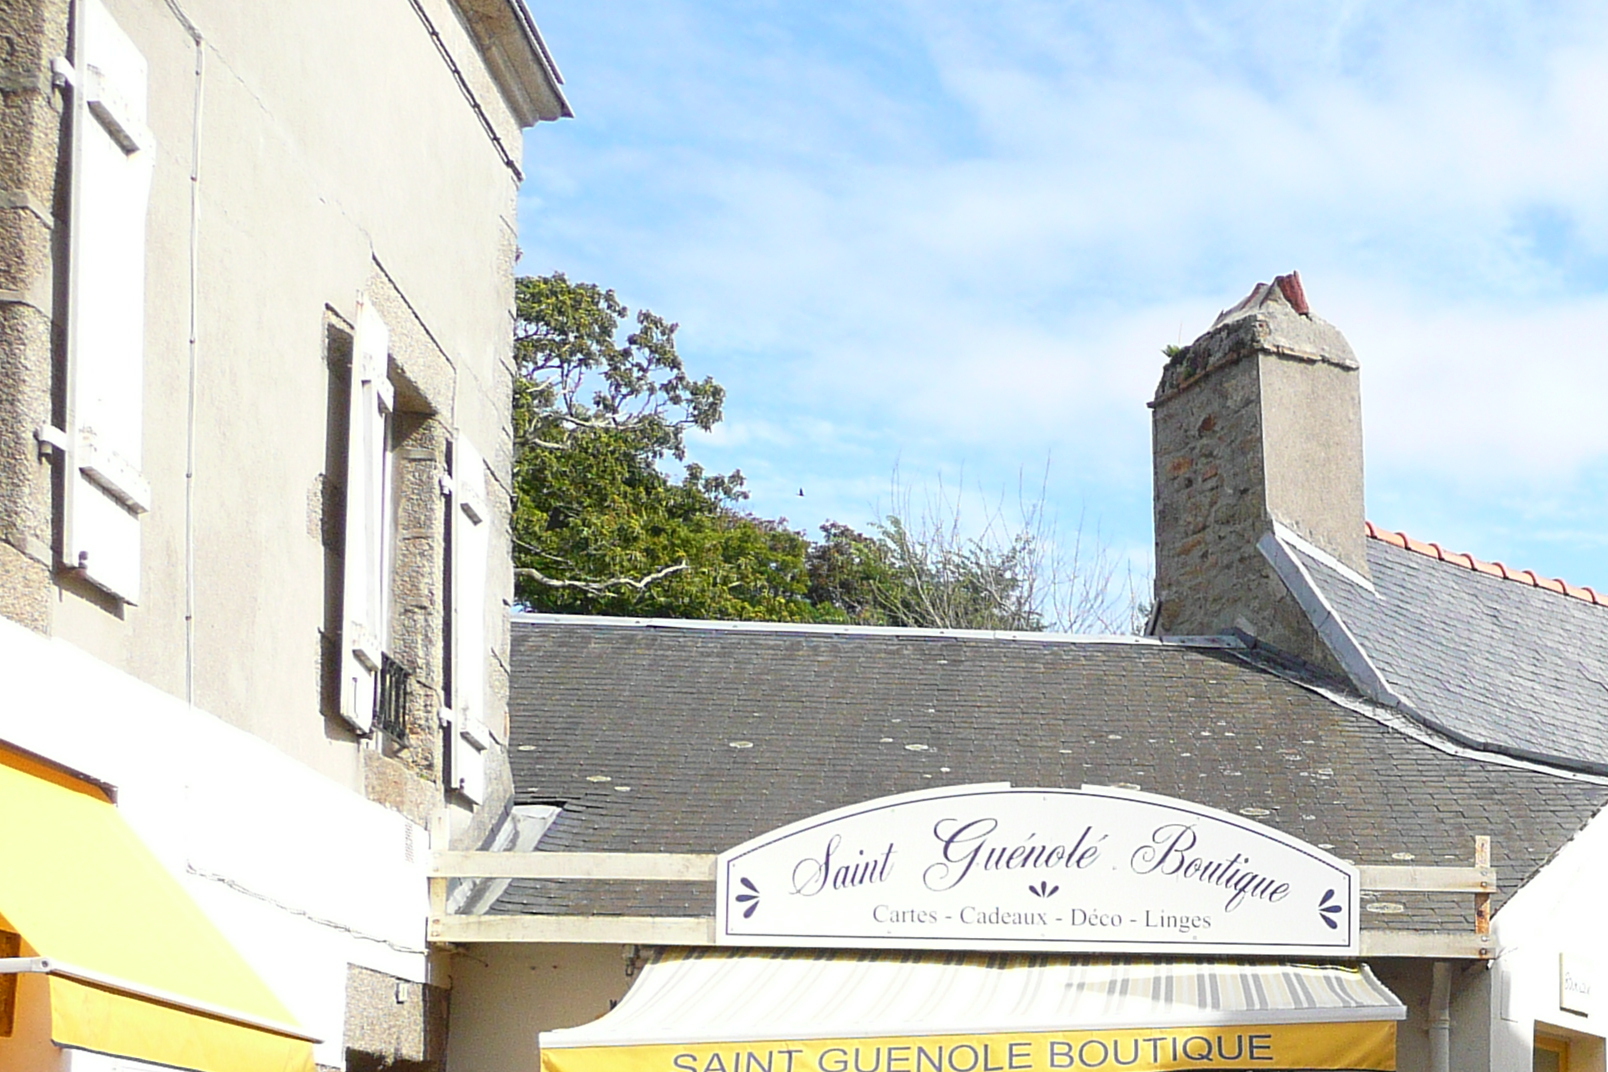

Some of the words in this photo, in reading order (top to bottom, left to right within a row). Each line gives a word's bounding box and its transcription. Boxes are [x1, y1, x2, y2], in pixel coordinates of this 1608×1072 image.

[788, 834, 897, 896] Saint
[922, 818, 1109, 892] Guénolé
[1130, 823, 1292, 914] Boutique
[872, 905, 938, 925] Cartes
[959, 905, 1048, 927] Cadeaux
[1070, 908, 1123, 929] Déco
[1144, 909, 1212, 933] Linges
[1048, 1033, 1274, 1069] BOUTIQUE
